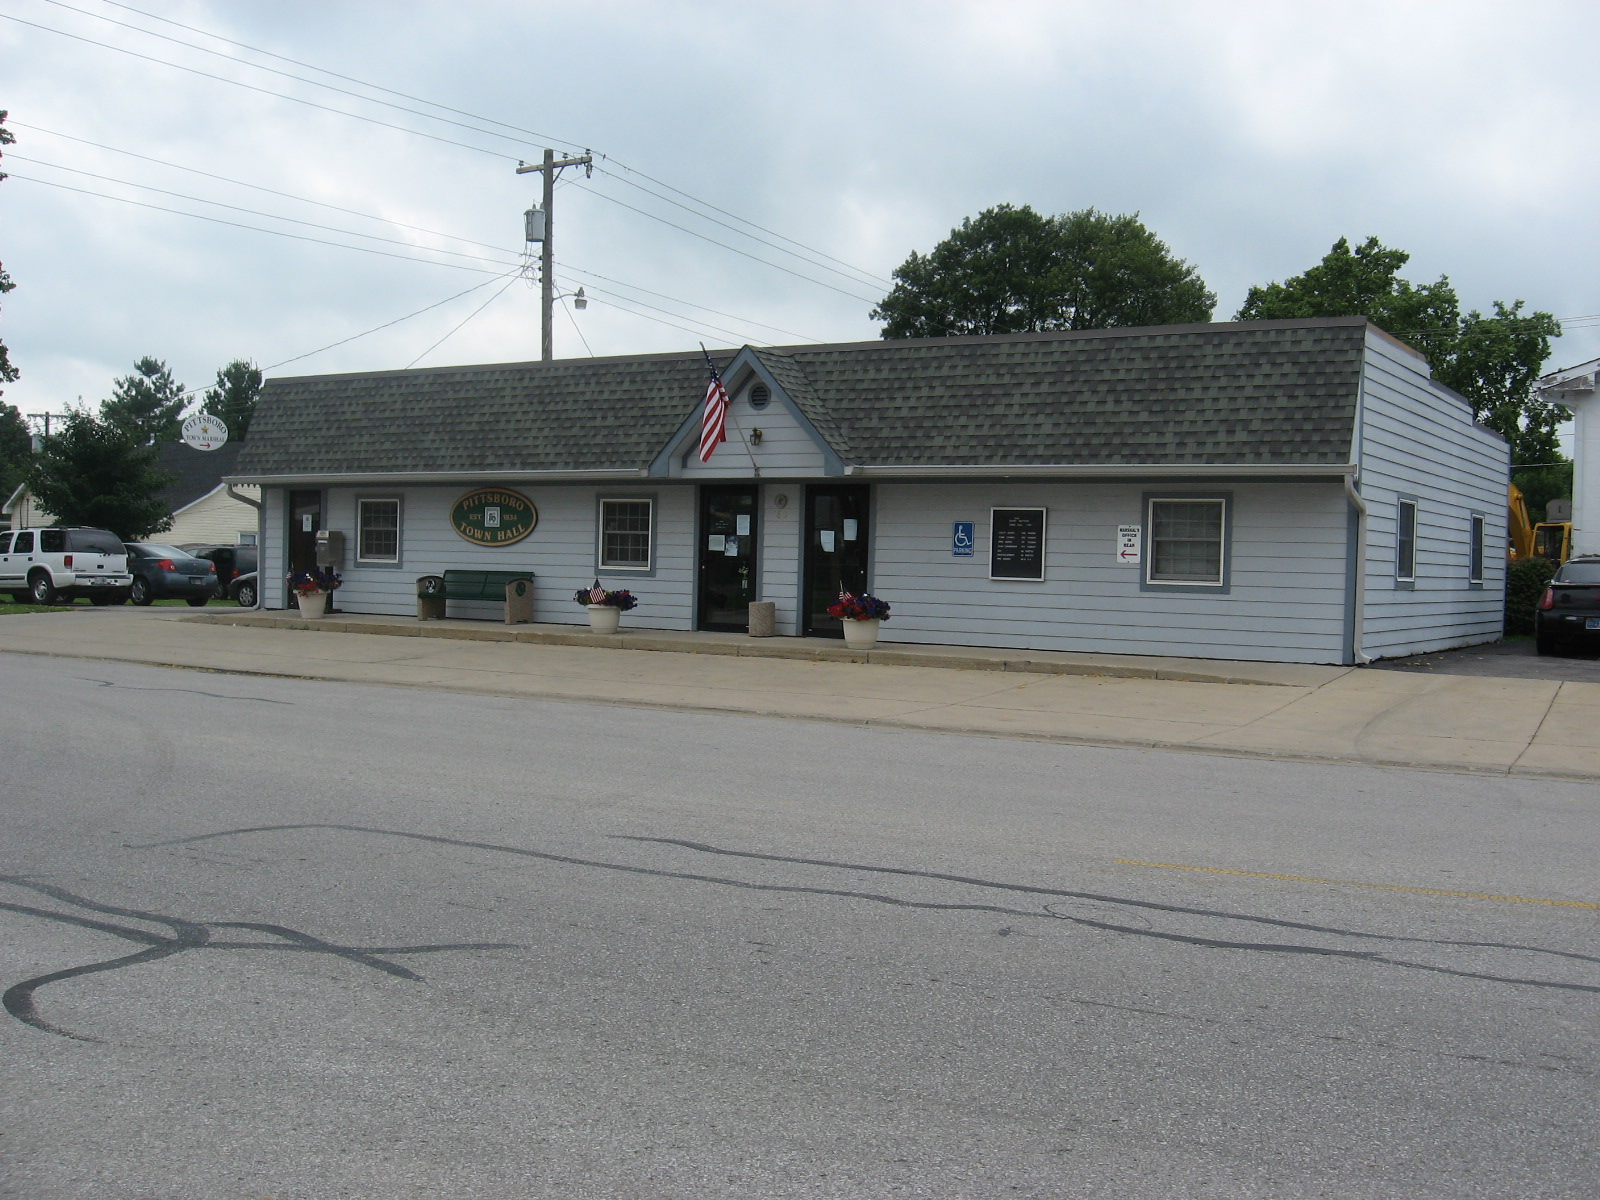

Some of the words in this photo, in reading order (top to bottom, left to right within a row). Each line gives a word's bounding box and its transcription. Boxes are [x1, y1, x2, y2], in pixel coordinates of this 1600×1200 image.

[184, 416, 226, 434] PITTSBORO
[463, 494, 524, 510] PITTSBORO
[460, 522, 491, 540] TOWN
[498, 524, 525, 540] HALL
